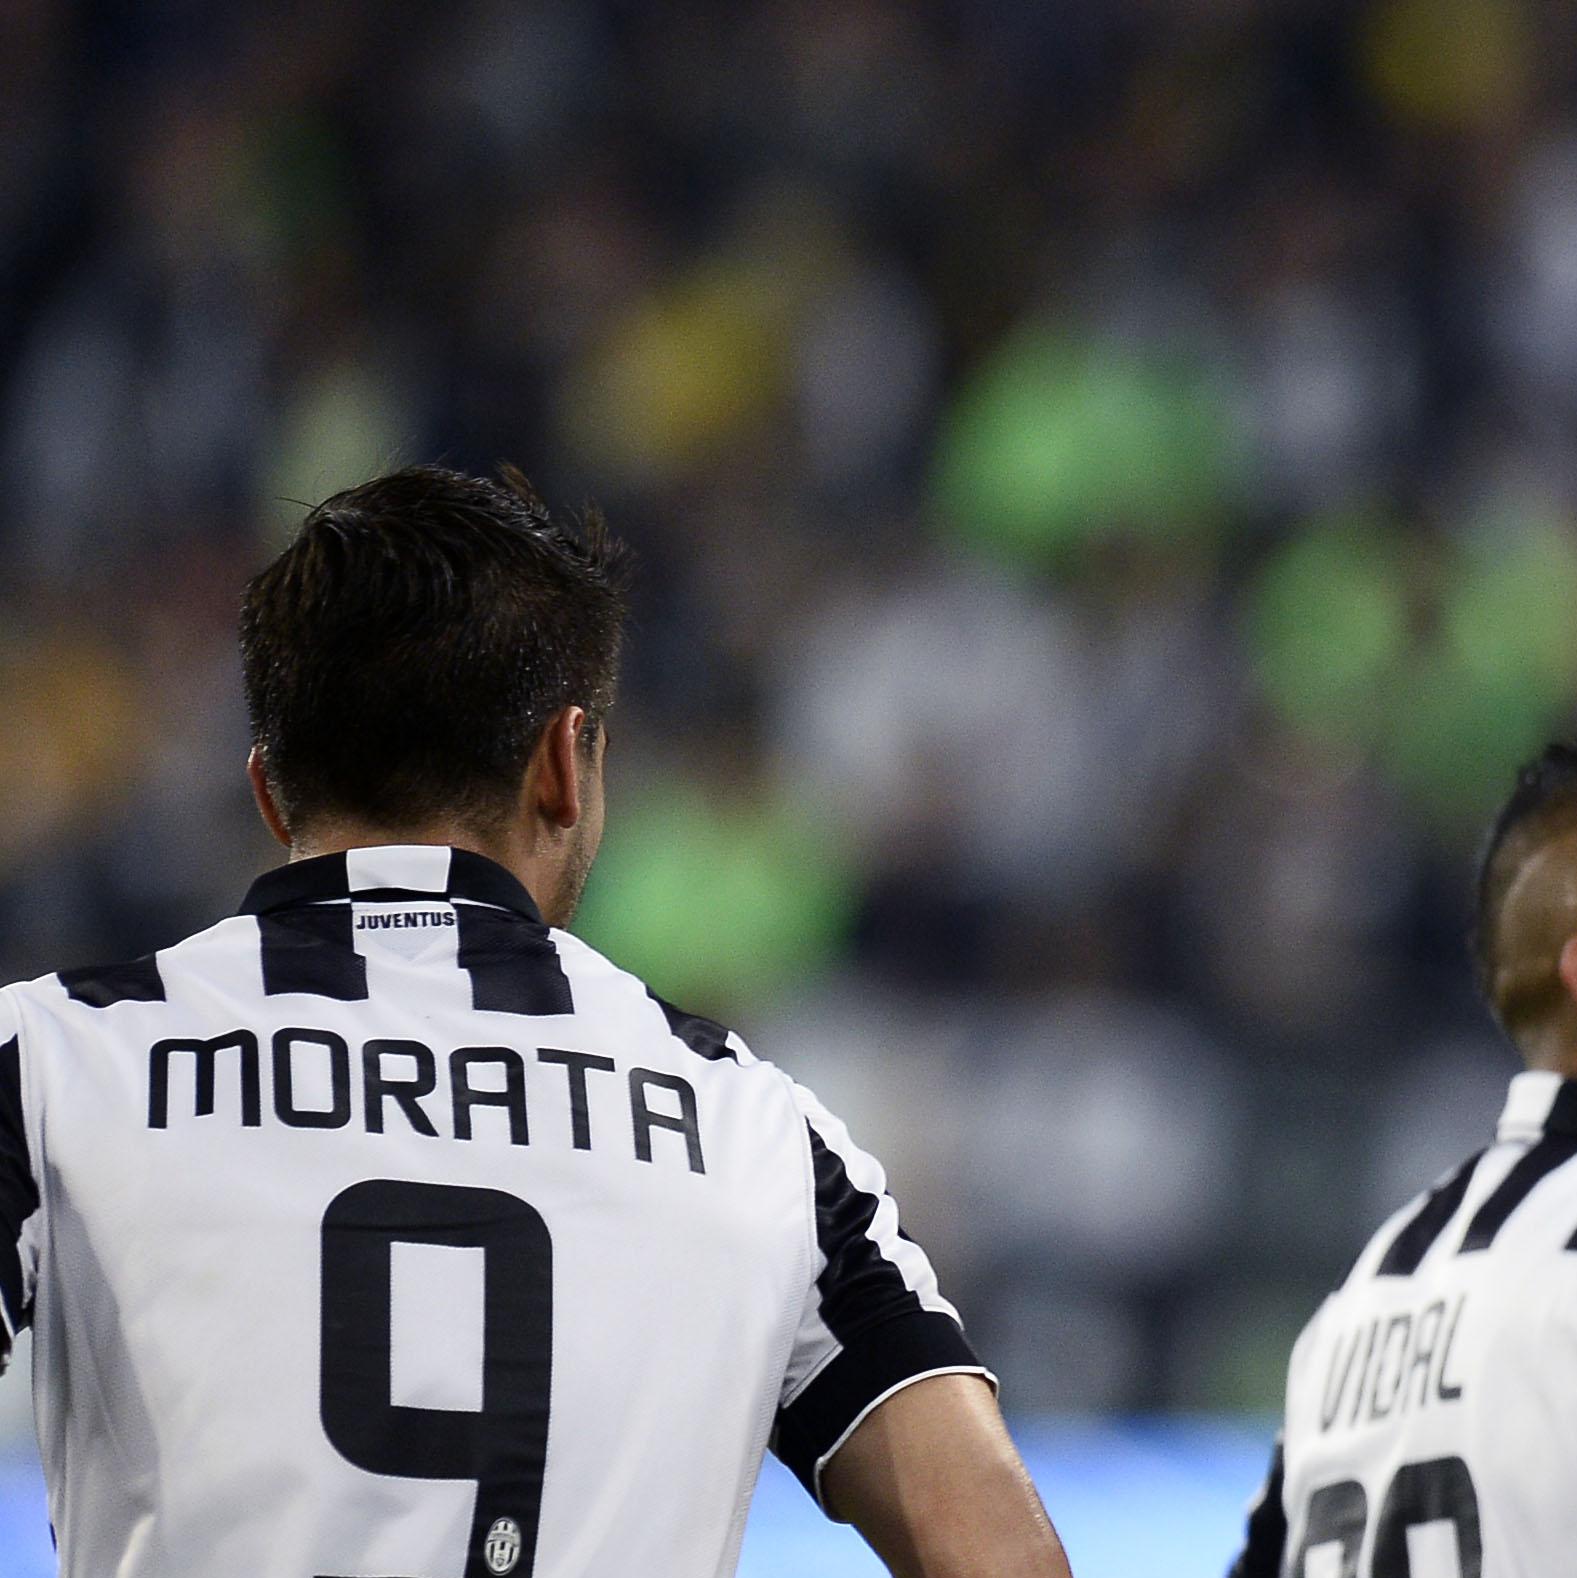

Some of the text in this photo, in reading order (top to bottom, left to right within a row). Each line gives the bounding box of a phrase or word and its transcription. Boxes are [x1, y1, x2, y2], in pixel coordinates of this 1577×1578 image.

[356, 911, 455, 930] JUVENTUS
[147, 1026, 706, 1175] MORATA
[1320, 1292, 1468, 1433] VIDAL
